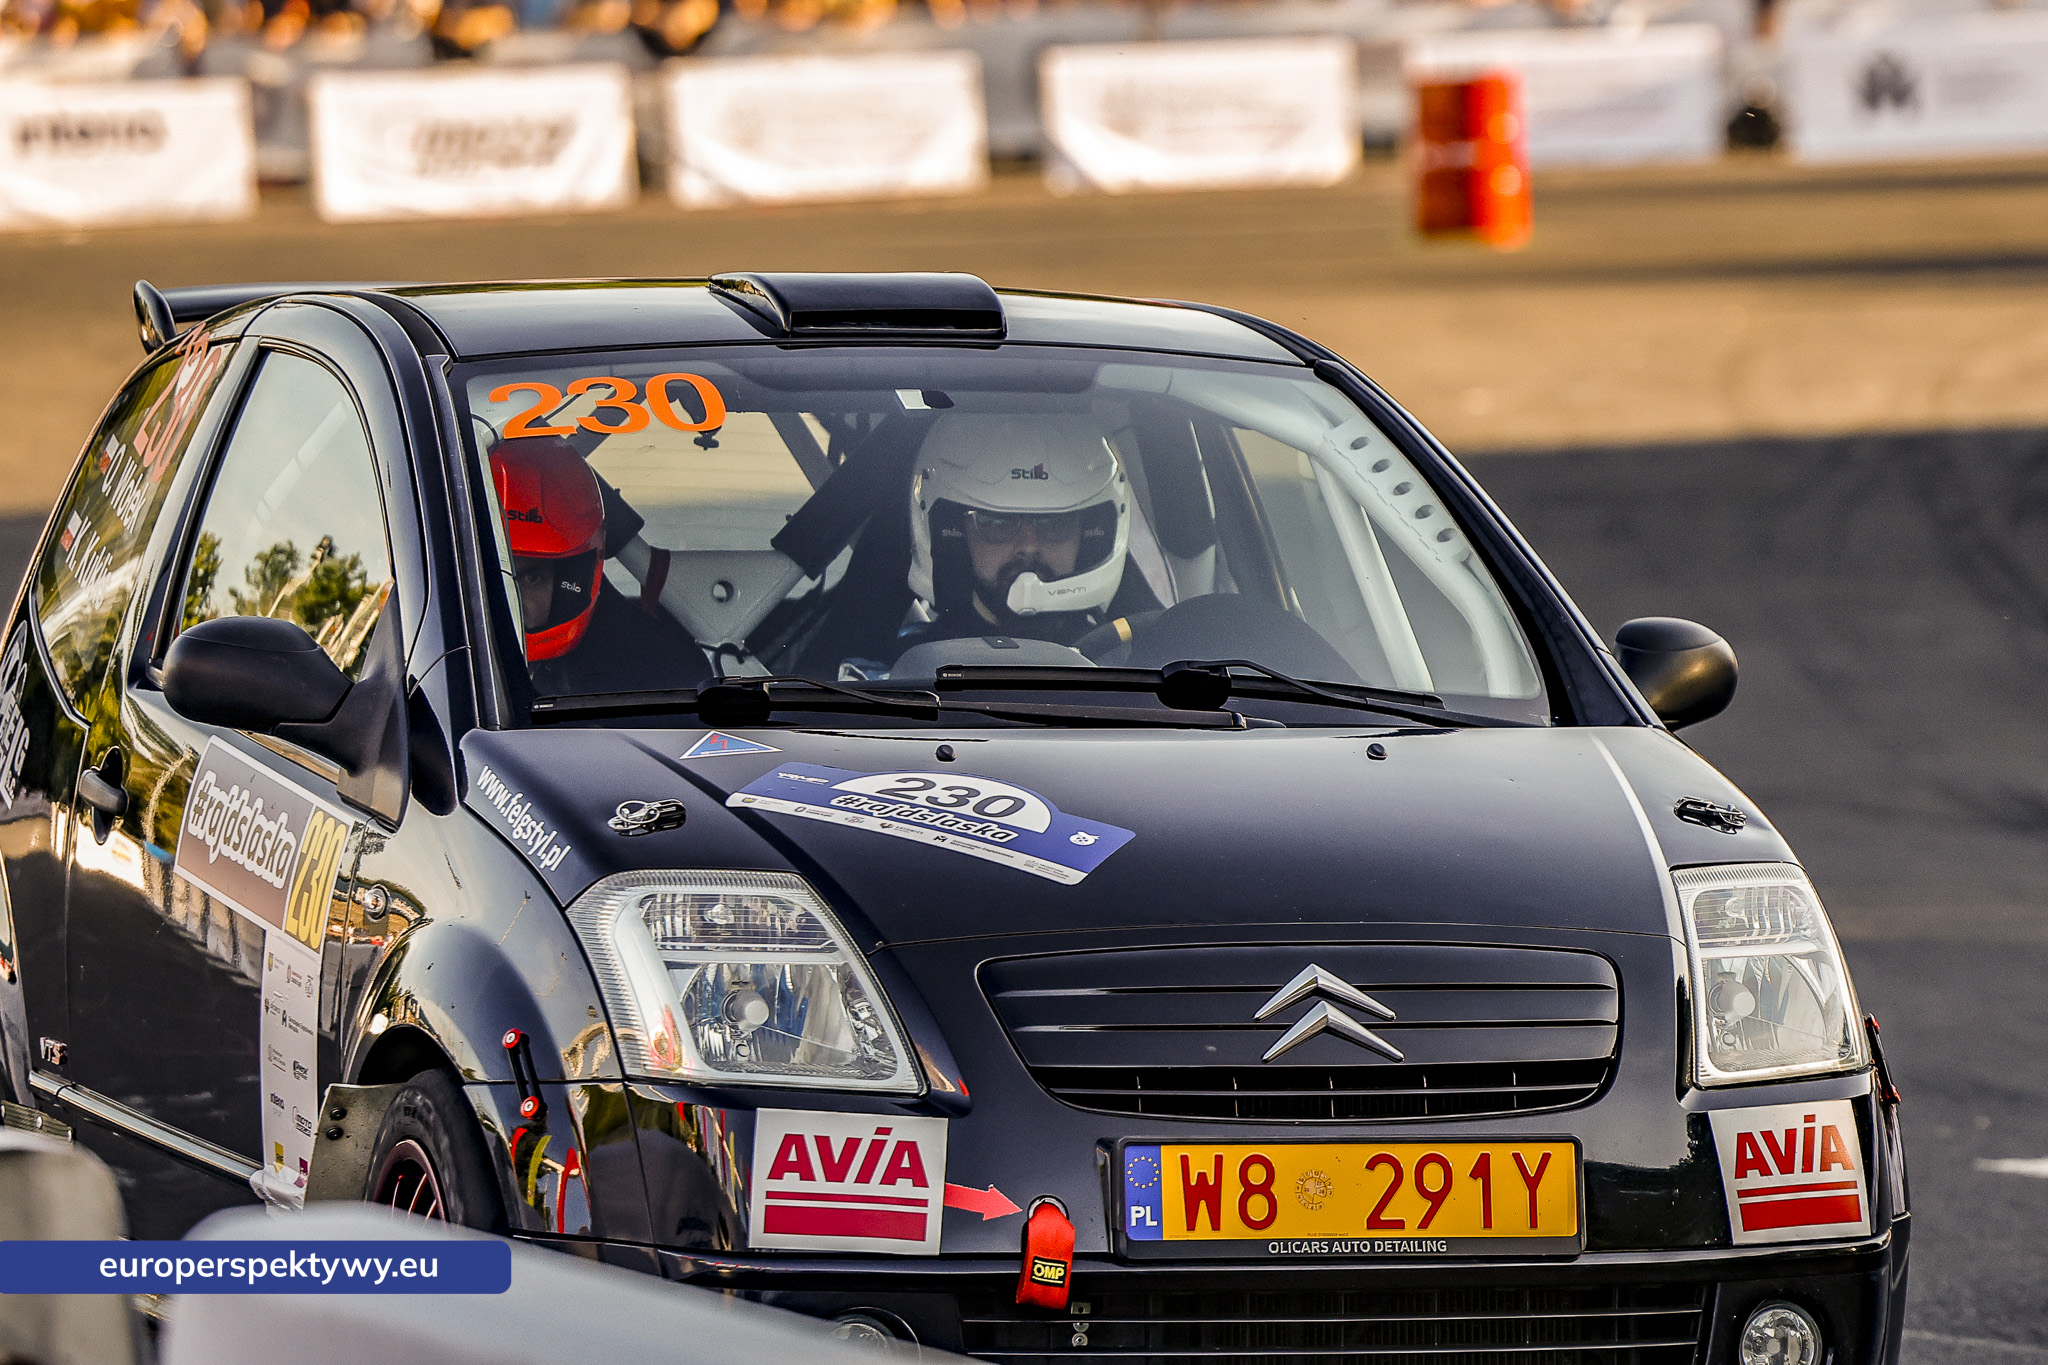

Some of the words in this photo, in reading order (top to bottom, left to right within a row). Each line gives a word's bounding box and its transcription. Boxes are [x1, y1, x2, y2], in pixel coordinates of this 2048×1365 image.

[489, 372, 727, 440] 230
[1011, 463, 1049, 481] Stilo
[507, 508, 544, 524] Stilo
[65, 516, 92, 572] K.
[561, 580, 582, 593] Stilo
[475, 765, 572, 872] www.felgstyl.pl
[834, 796, 1013, 841] #rajdslaska
[875, 776, 1026, 819] 230
[190, 783, 291, 881] #rajdslaska
[286, 811, 346, 949] 230
[1180, 1153, 1279, 1232] W8
[1364, 1151, 1553, 1232] 291Y
[1130, 1205, 1158, 1227] PL
[1268, 1241, 1329, 1254] OLICARS
[1332, 1241, 1370, 1254] AUTO
[1374, 1240, 1447, 1254] DETAILING
[1033, 1263, 1065, 1280] OMP
